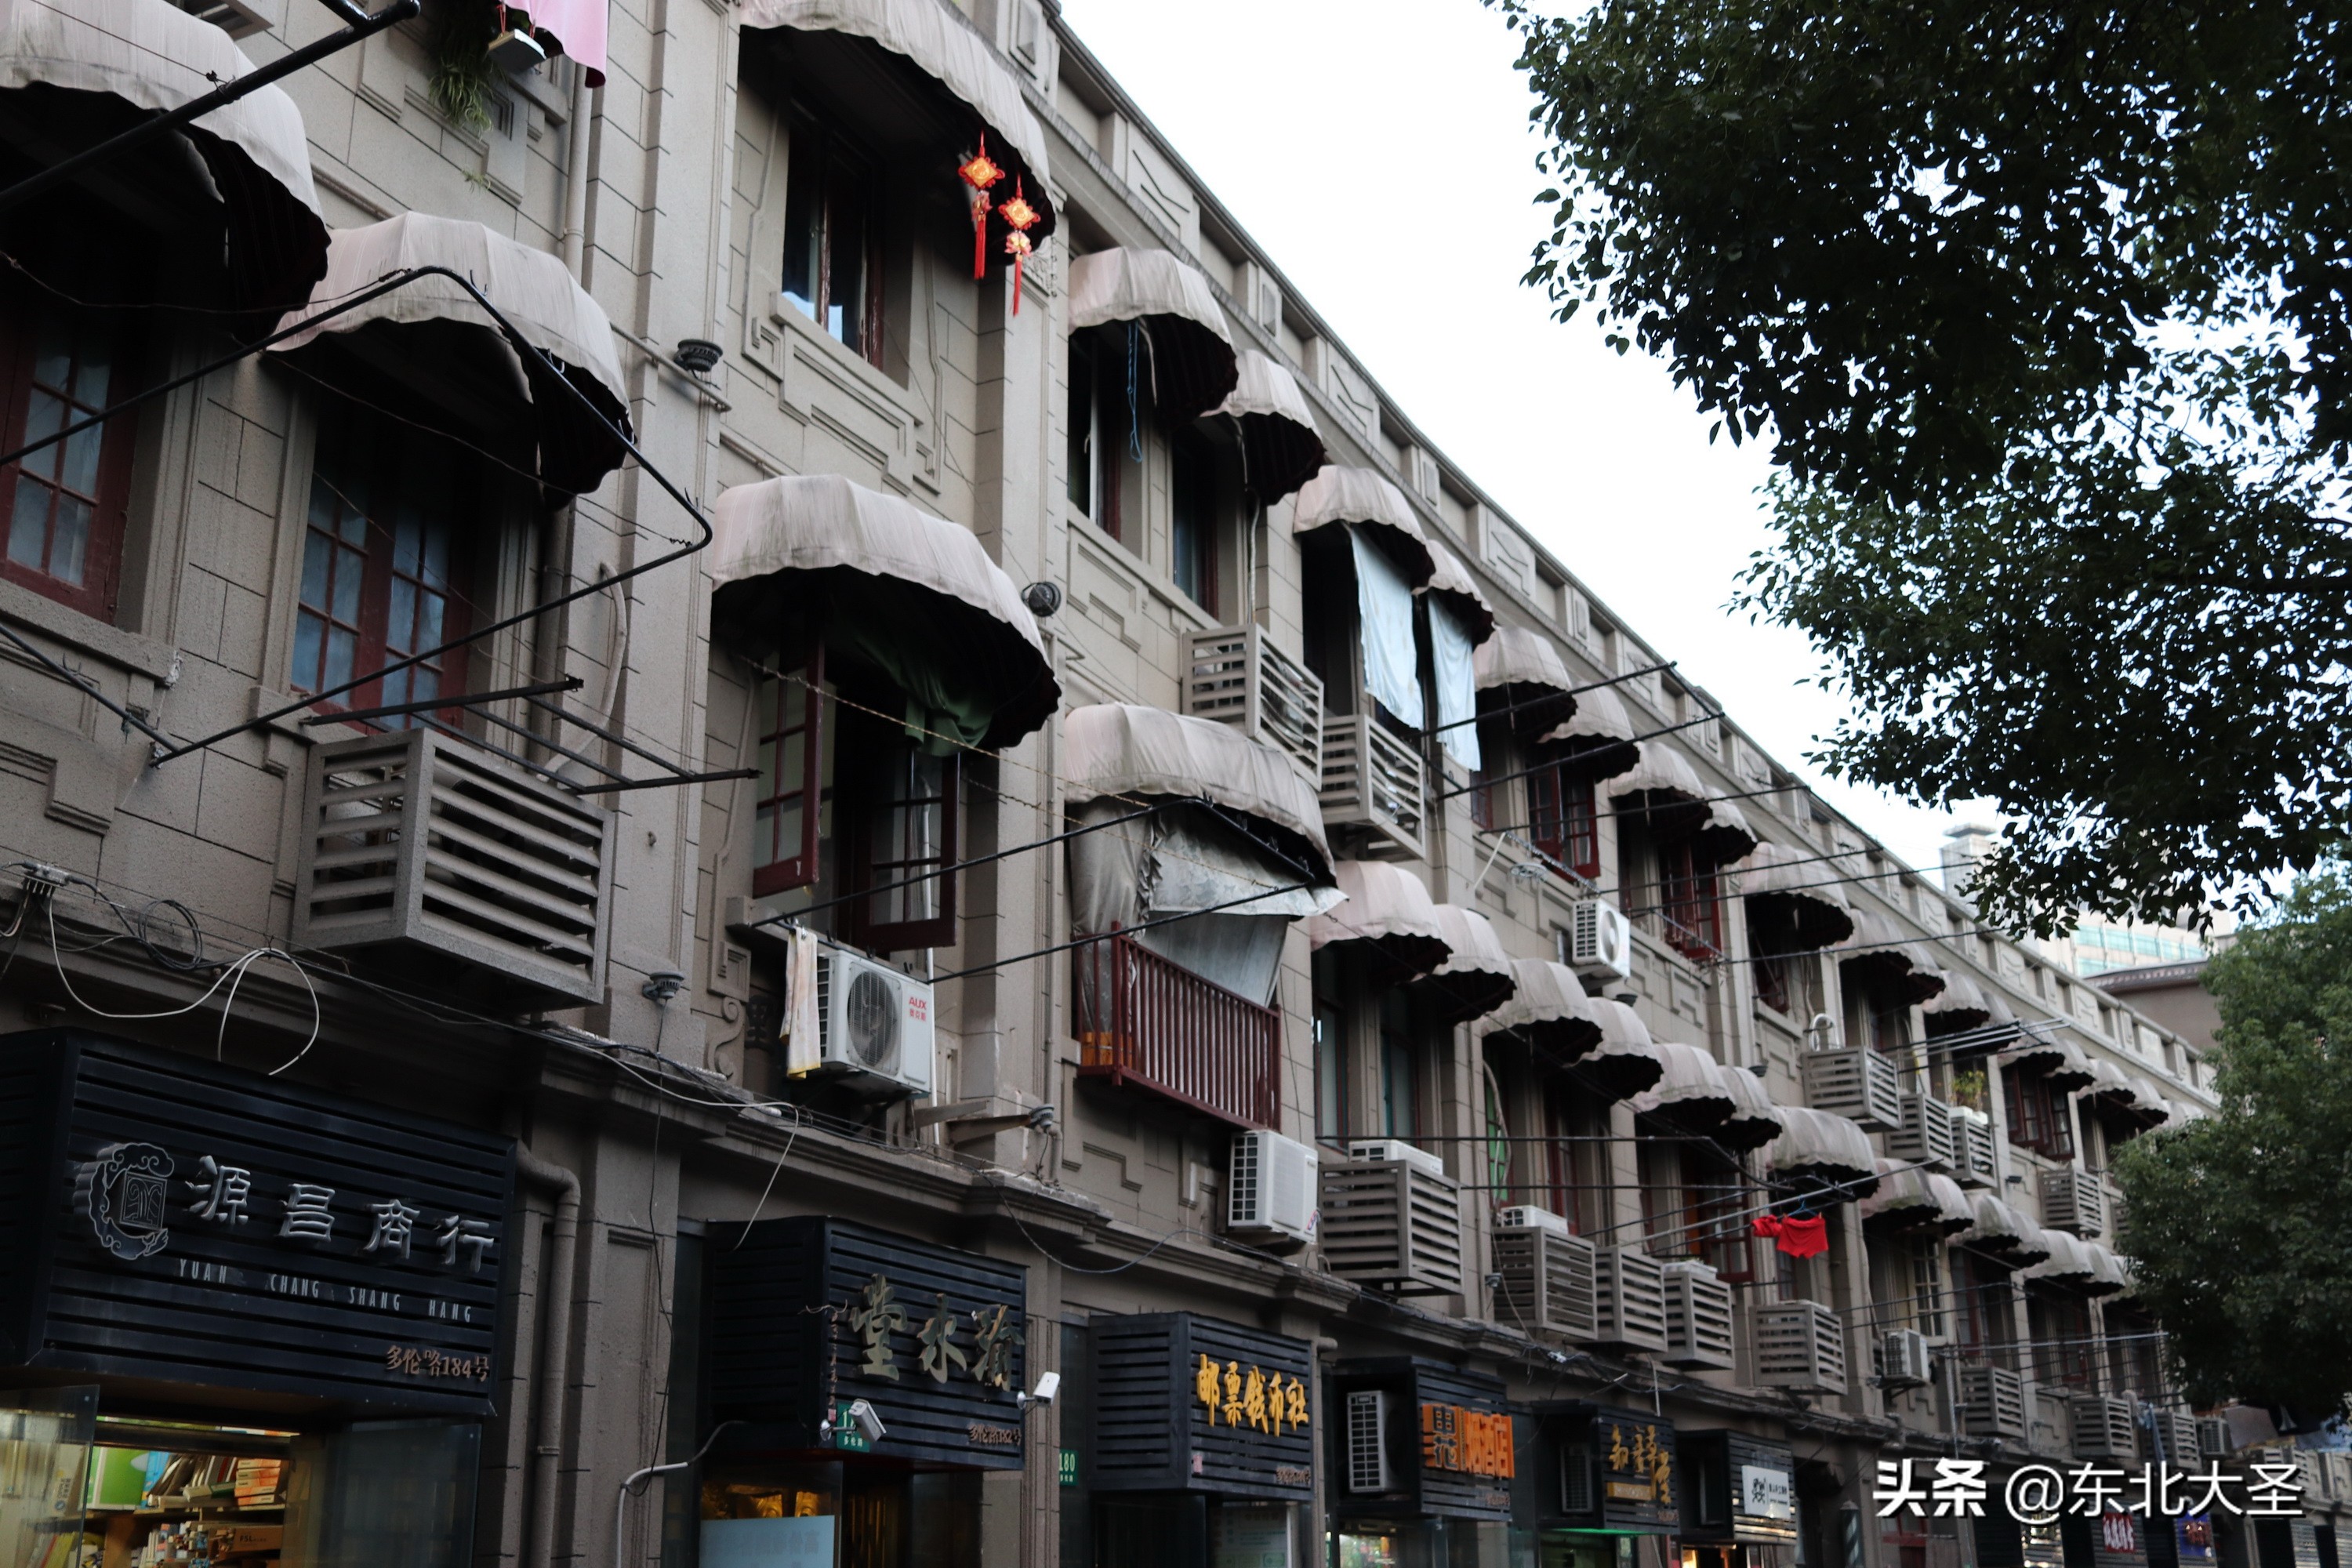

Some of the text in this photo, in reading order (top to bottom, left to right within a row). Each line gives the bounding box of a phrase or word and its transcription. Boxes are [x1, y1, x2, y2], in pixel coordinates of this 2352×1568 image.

[909, 996, 927, 1011] AUX
[185, 1156, 495, 1273] 源昌商行
[179, 1258, 471, 1323] YUAN CHANG SHANG HANG
[1196, 1353, 1309, 1437] 邮票钱币社
[1059, 1453, 1076, 1472] 180
